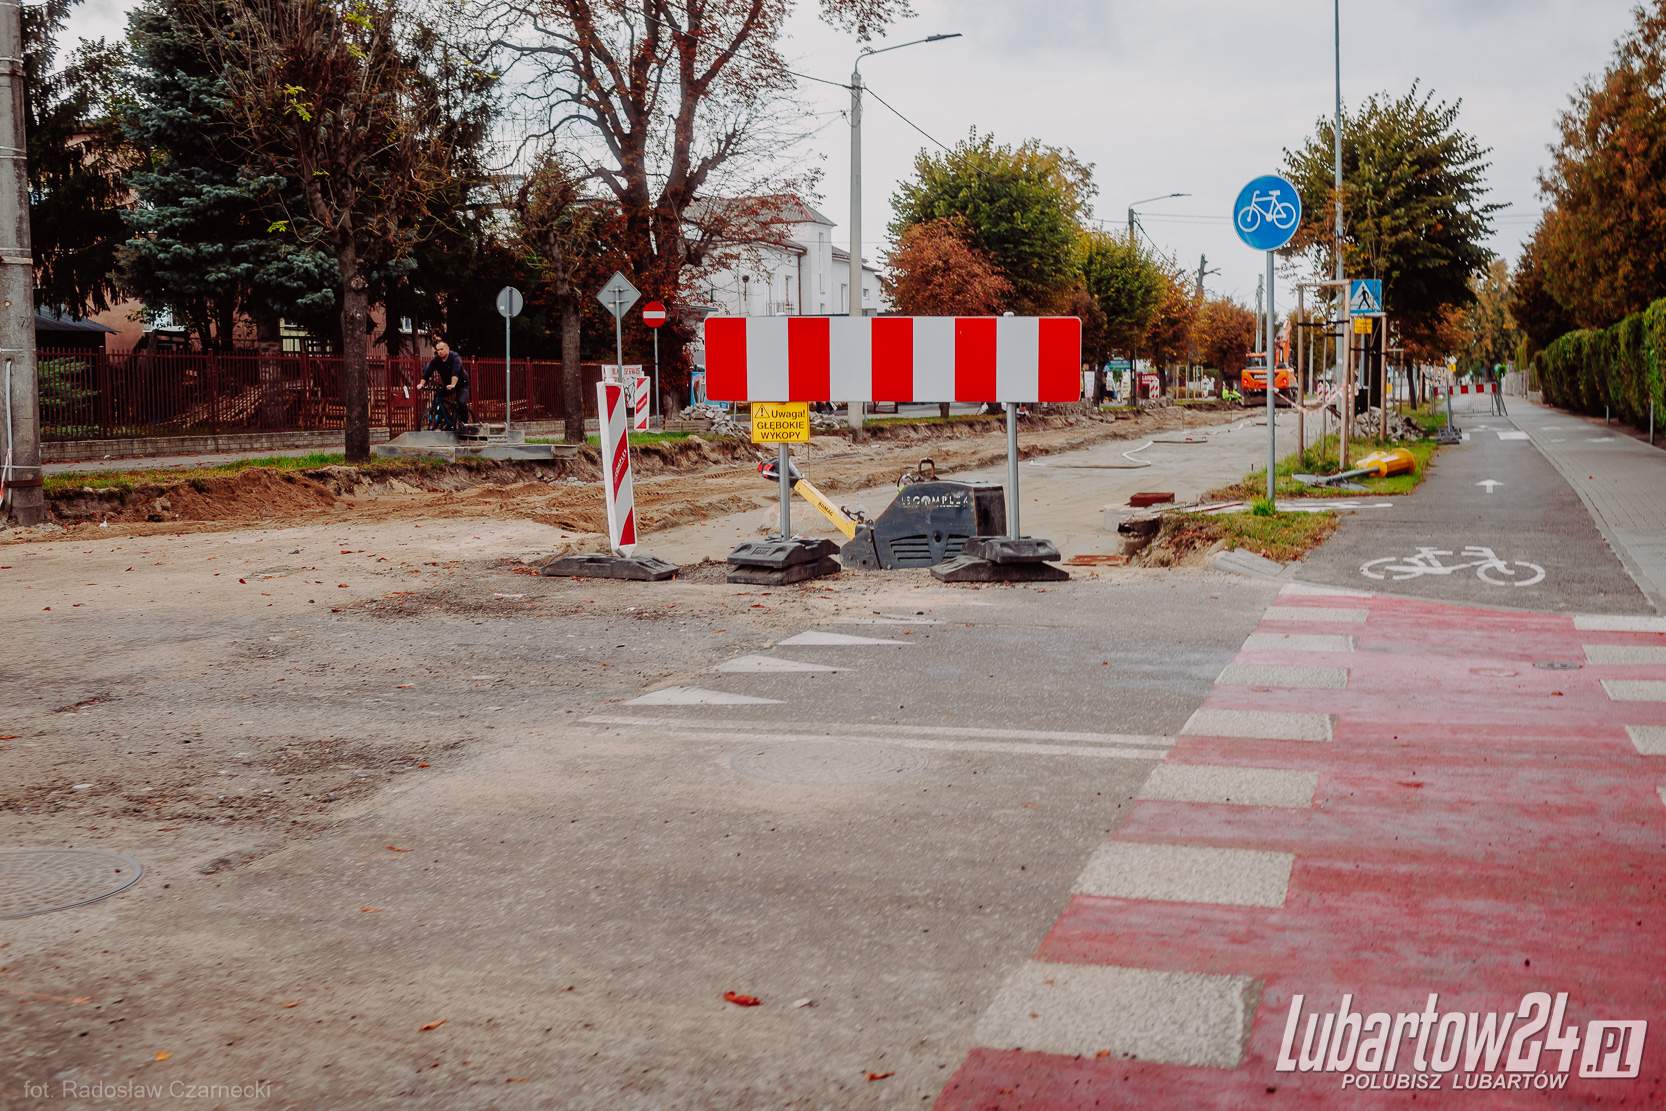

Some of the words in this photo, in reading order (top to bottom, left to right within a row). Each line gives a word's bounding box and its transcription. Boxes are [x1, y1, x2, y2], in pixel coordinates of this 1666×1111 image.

[771, 410, 806, 420] Uwaga!
[756, 421, 805, 431] GŁĘBOKIE
[760, 431, 801, 439] WYKOPY
